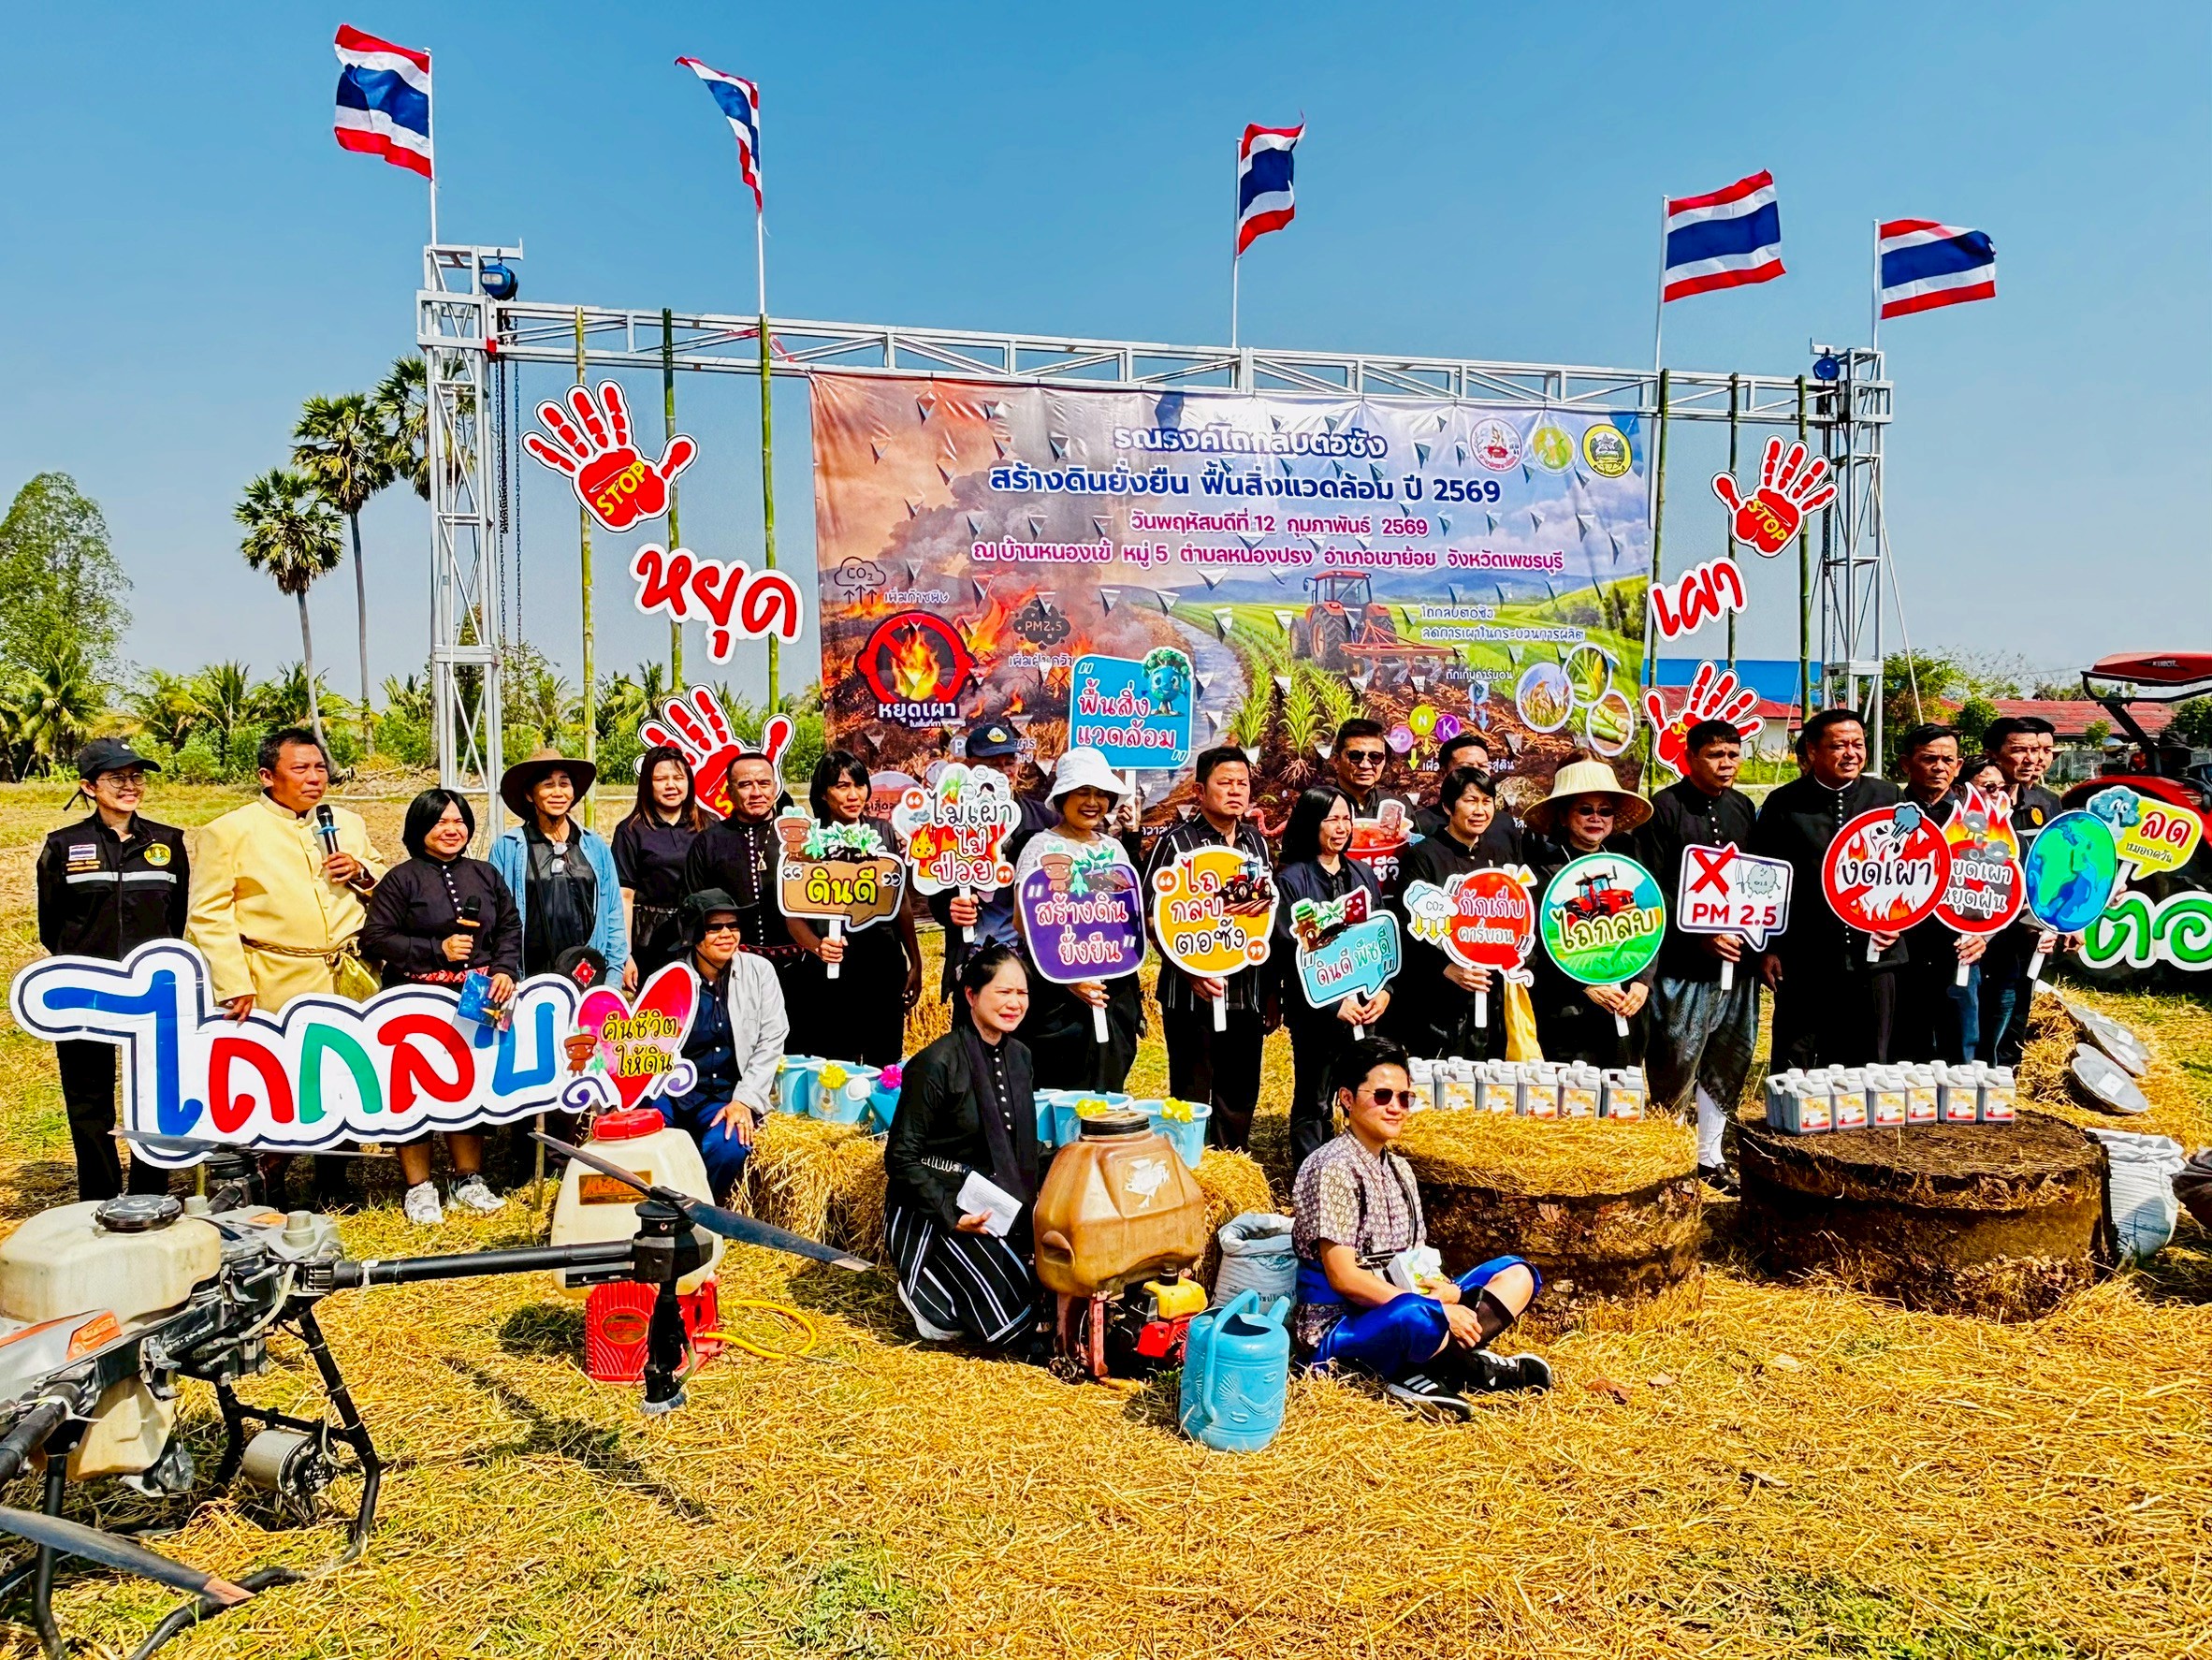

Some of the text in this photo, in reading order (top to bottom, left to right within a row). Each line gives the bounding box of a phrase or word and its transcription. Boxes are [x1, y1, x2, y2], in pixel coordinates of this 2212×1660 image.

[596, 459, 646, 517] STOP
[991, 461, 1500, 502] สร้างดินยั่งยืน ฟื้นสิ่งแวดล้อม ปี 2569
[1255, 515, 1275, 531] 12
[1287, 515, 1371, 538] กุมภาพันธ์
[1381, 517, 1428, 535] 2569
[1747, 499, 1788, 543] STOP
[1123, 542, 1150, 567] หมู่
[1156, 546, 1169, 561] 5
[1180, 543, 1312, 564] ตำบลหนองปรง
[1324, 545, 1437, 566] อำเภอเขาย้อย
[1447, 548, 1564, 574] จังหวัดเพชรบุรี
[636, 550, 797, 659] หยุด
[1653, 562, 1743, 636] เผา
[1025, 620, 1063, 632] PM2.5
[879, 702, 956, 722] หยุดเผา
[1079, 678, 1149, 717] ฟื้นสิ่ง
[1078, 720, 1175, 749] แวดล้อม
[1418, 714, 1453, 736] N K
[926, 791, 1012, 824] ไม่เผา
[956, 823, 987, 856] ไม่
[2140, 810, 2191, 849] ลด
[808, 867, 877, 904] ดินดี
[934, 856, 994, 884] ป่วย
[1181, 858, 1219, 894] ไถ
[1841, 862, 1931, 887] งดเผา
[1953, 861, 2011, 885] ยุดเผา
[1036, 893, 1128, 925] สร้างดิน
[1171, 896, 1223, 922] กลบ
[1461, 888, 1525, 918] กักเก็บ
[1692, 903, 1777, 926] PM 2.5
[1059, 924, 1122, 963] ยั่งยืน
[1175, 921, 1246, 955] ตอซัง
[1459, 921, 1514, 943] คาร์บอน
[1551, 910, 1655, 950] ไถกลบ
[603, 1009, 677, 1041] คืนชีวิต
[42, 969, 556, 1136] ไถกลบ
[615, 1044, 673, 1077] ให้ดิน
